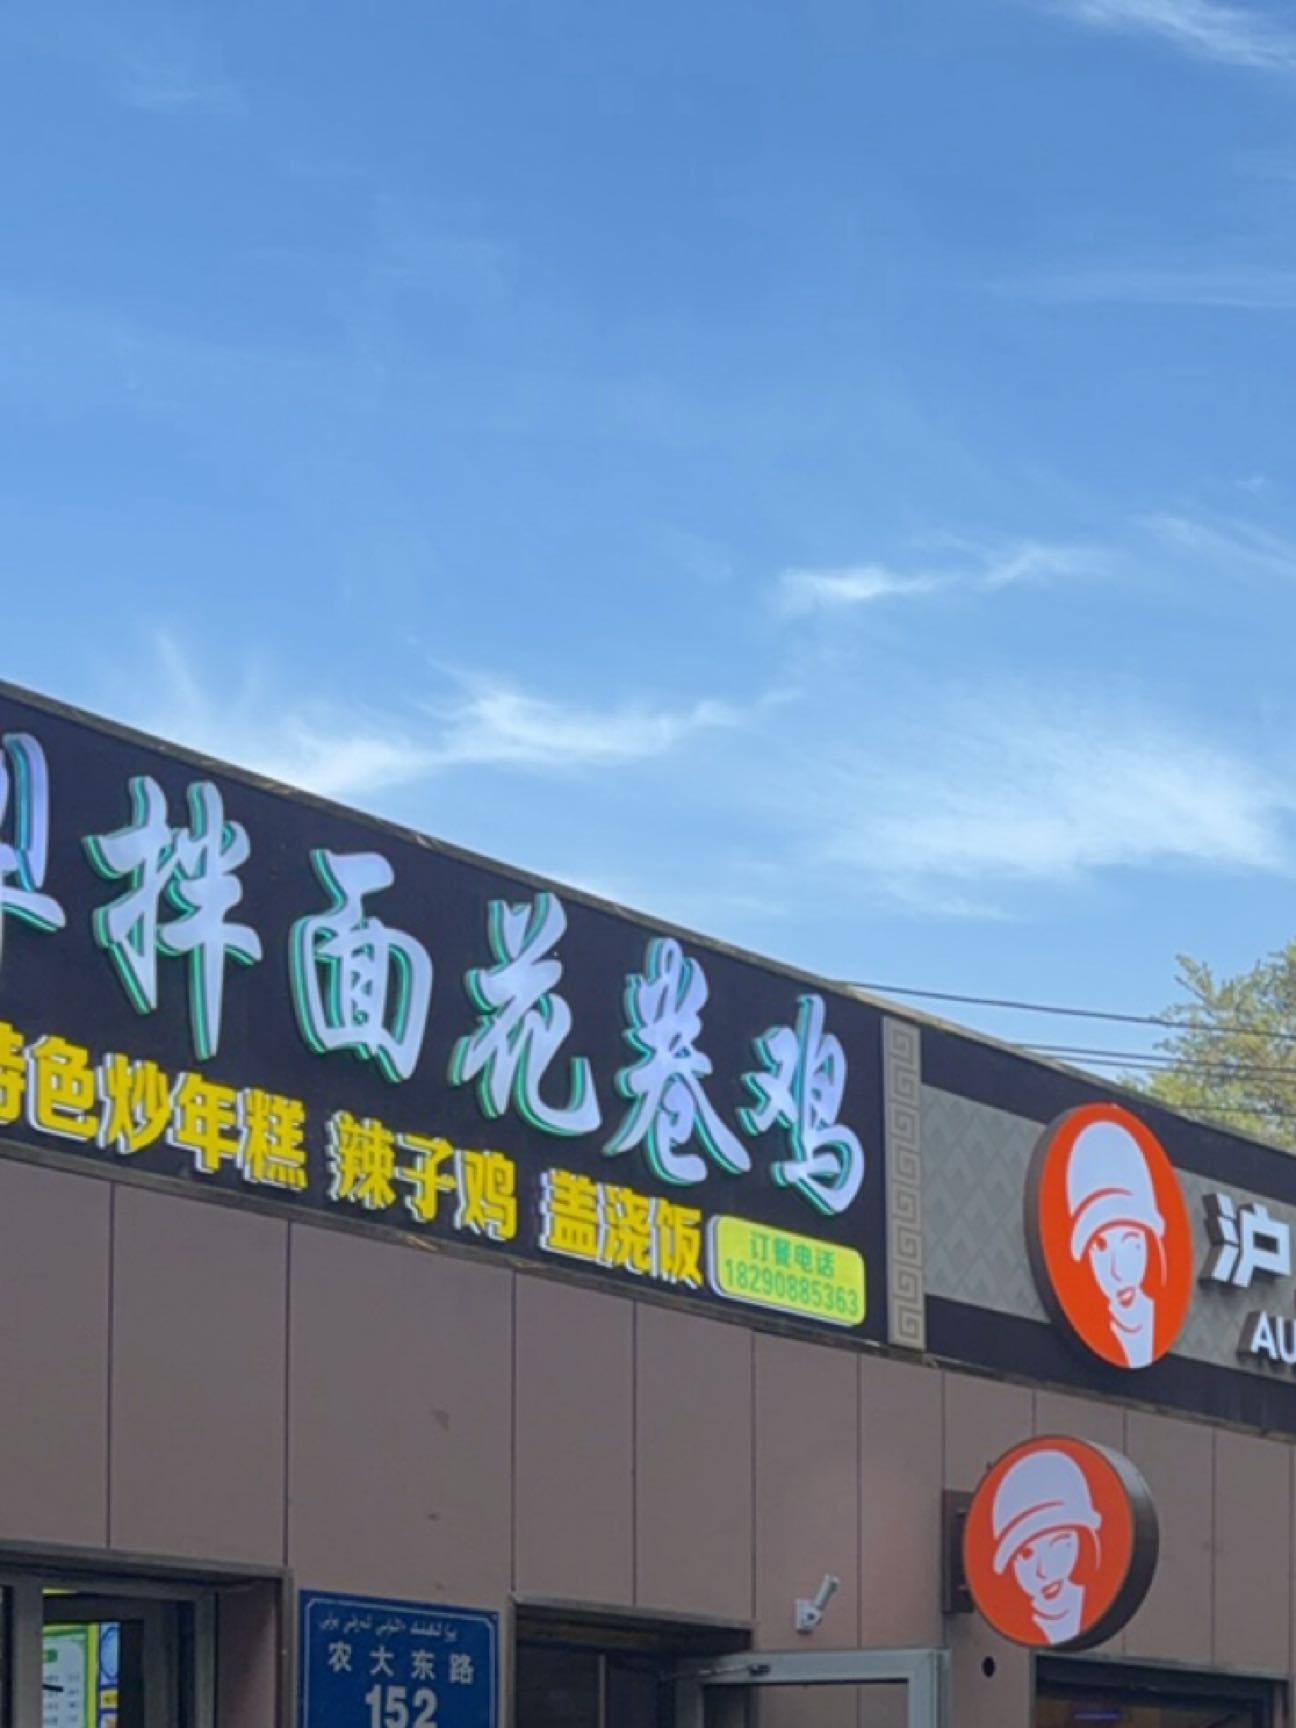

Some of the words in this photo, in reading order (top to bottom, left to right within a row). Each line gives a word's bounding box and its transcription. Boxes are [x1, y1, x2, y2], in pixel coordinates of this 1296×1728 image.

[329, 1110, 518, 1242] 辣子鸡
[539, 1168, 704, 1289] 盖浇饭
[749, 1230, 836, 1278] 订餐电话
[327, 1640, 475, 1685] 农大东路
